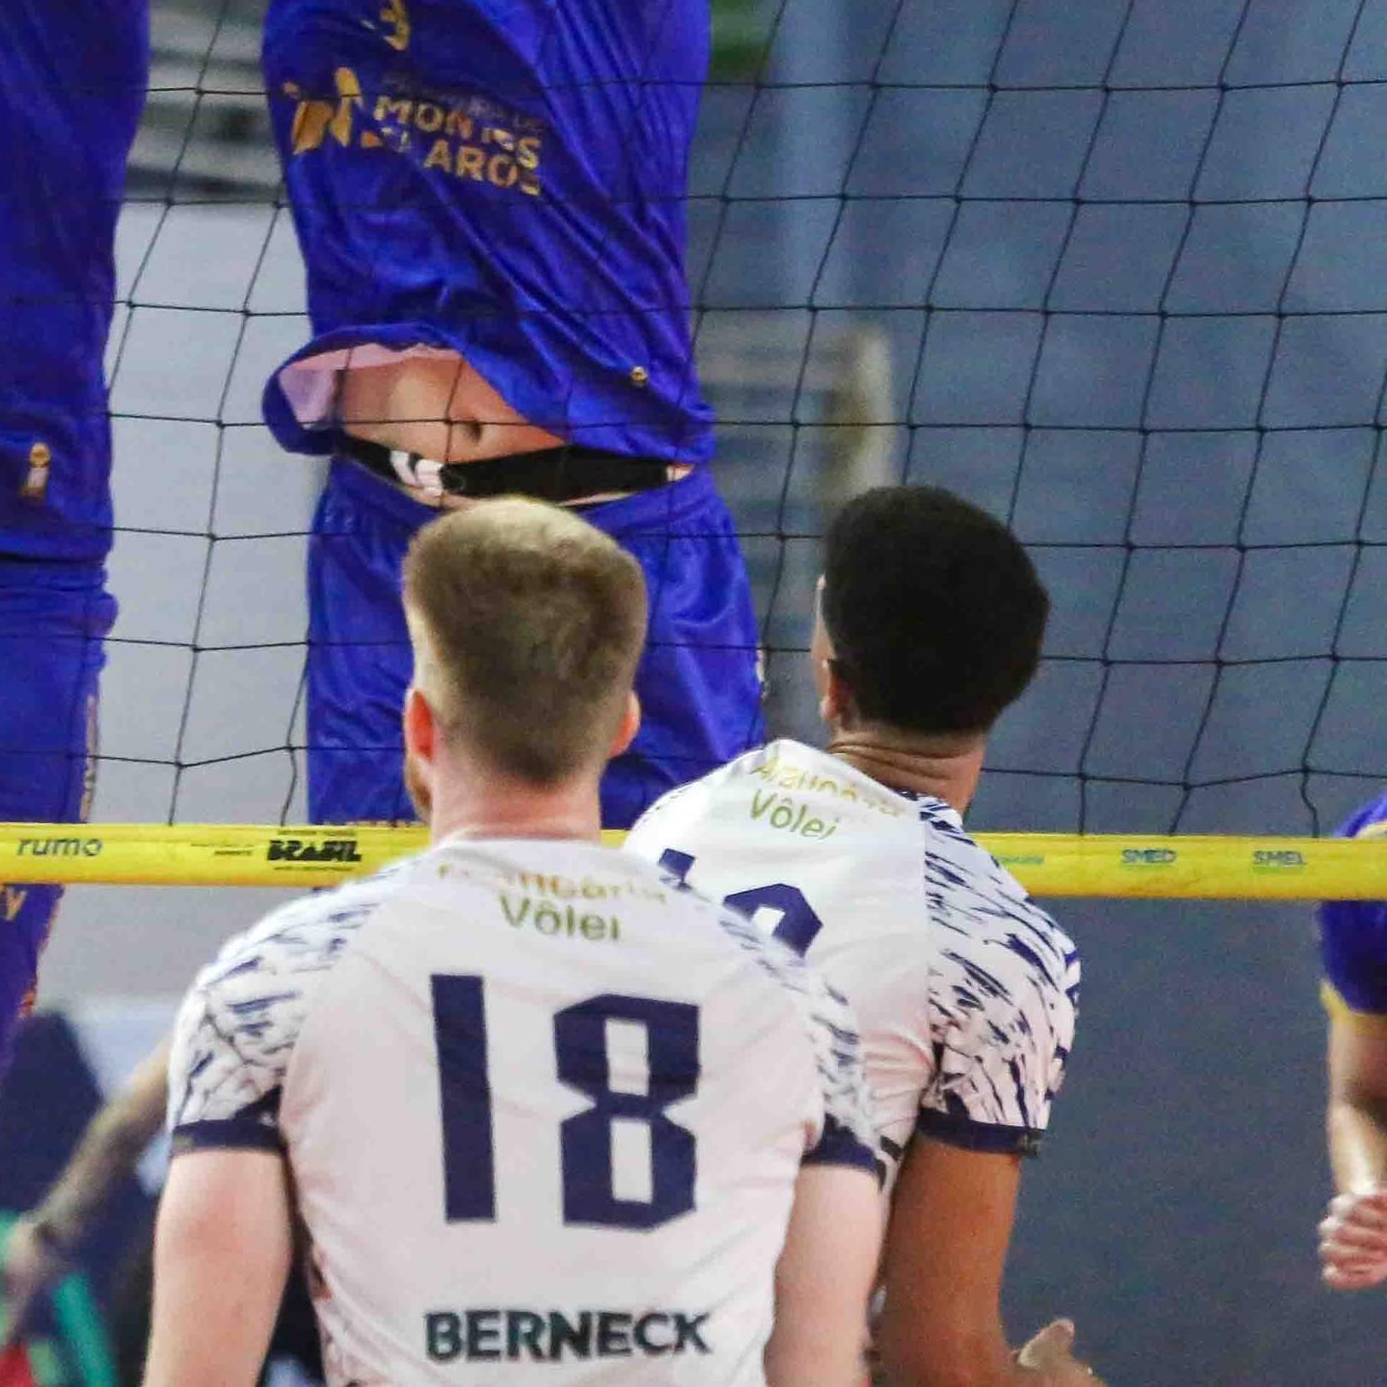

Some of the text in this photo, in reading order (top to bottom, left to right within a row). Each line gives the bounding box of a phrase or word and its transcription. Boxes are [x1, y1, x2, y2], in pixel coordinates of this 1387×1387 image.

[749, 788, 840, 840] Vôlei
[16, 836, 103, 857] rumo
[498, 890, 621, 942] Vôlei
[430, 973, 702, 1232] 18
[427, 1309, 711, 1364] BERNECK
